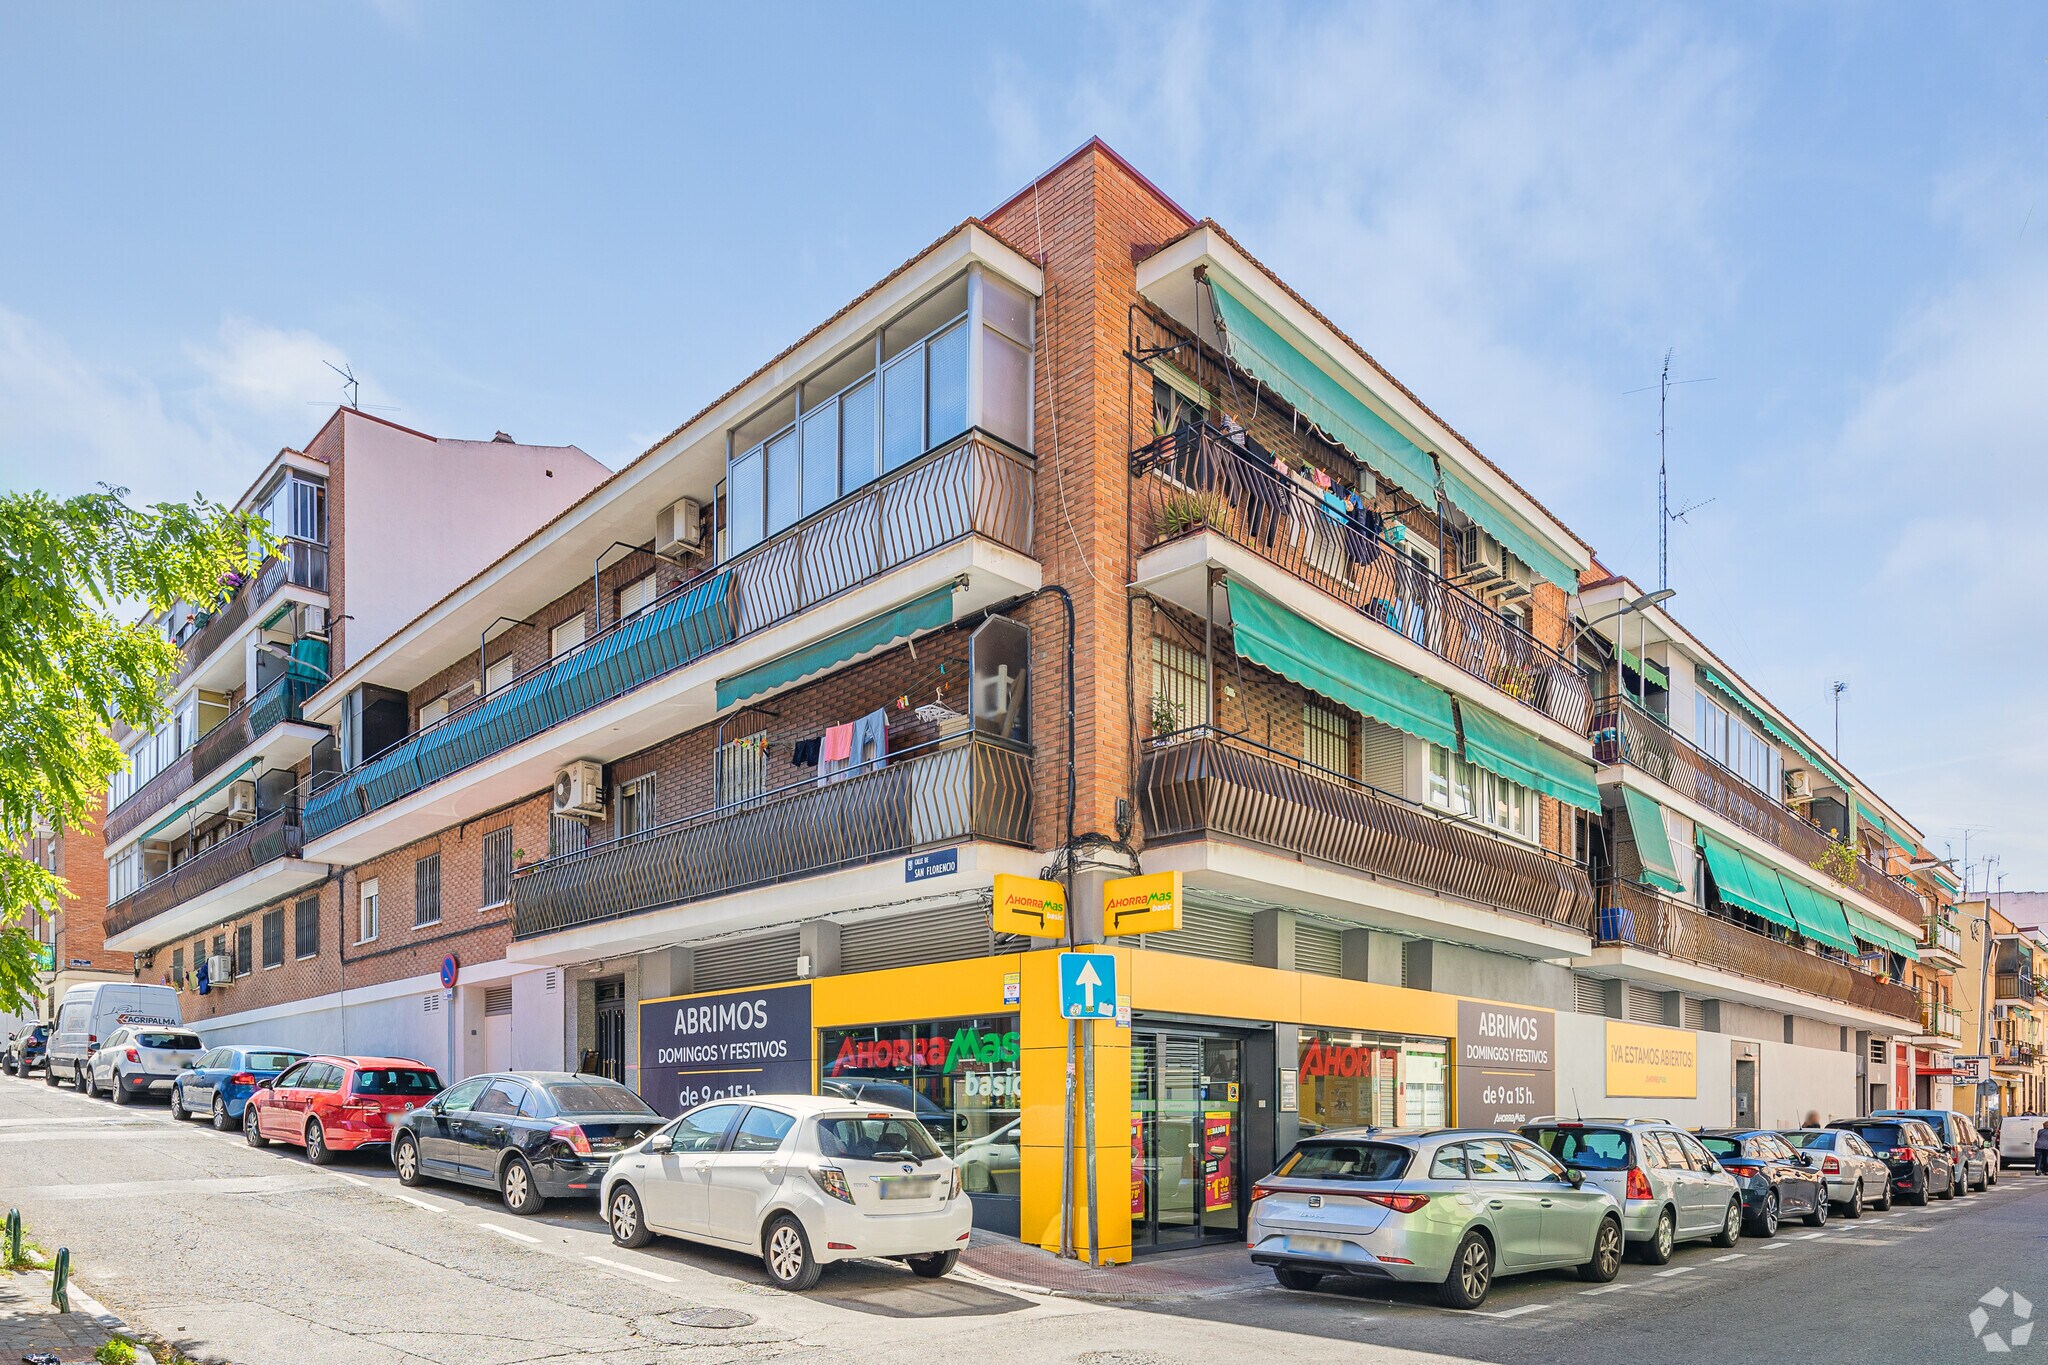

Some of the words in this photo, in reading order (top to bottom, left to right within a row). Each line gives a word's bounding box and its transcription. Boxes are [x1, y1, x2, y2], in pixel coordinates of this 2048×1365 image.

[914, 868, 925, 878] SAN
[926, 861, 956, 876] FLORENCIO
[1046, 912, 1063, 921] basic
[1152, 902, 1172, 913] basic
[674, 999, 768, 1036] ABRIMOS
[1478, 1011, 1538, 1041] ABRIMOS
[658, 1045, 718, 1064] DOMINGOS
[720, 1044, 728, 1060] Y
[730, 1040, 787, 1060] FESTIVOS
[1466, 1044, 1509, 1061] DOMINGOS
[1509, 1048, 1515, 1061] Y
[1515, 1048, 1548, 1064] FESTIVOS
[1611, 1044, 1624, 1063] ¡YA
[1625, 1046, 1660, 1066] ESTAMOS
[1660, 1049, 1694, 1068] ABIERTOS!
[965, 1067, 1021, 1097] basic
[680, 1086, 699, 1106] de
[701, 1085, 711, 1102] 9
[714, 1089, 725, 1100] a
[728, 1085, 743, 1098] 15
[1483, 1085, 1497, 1105] de
[1498, 1086, 1505, 1104] 9
[1506, 1089, 1514, 1104] a
[1515, 1086, 1525, 1105] 15
[1526, 1086, 1535, 1105] h.
